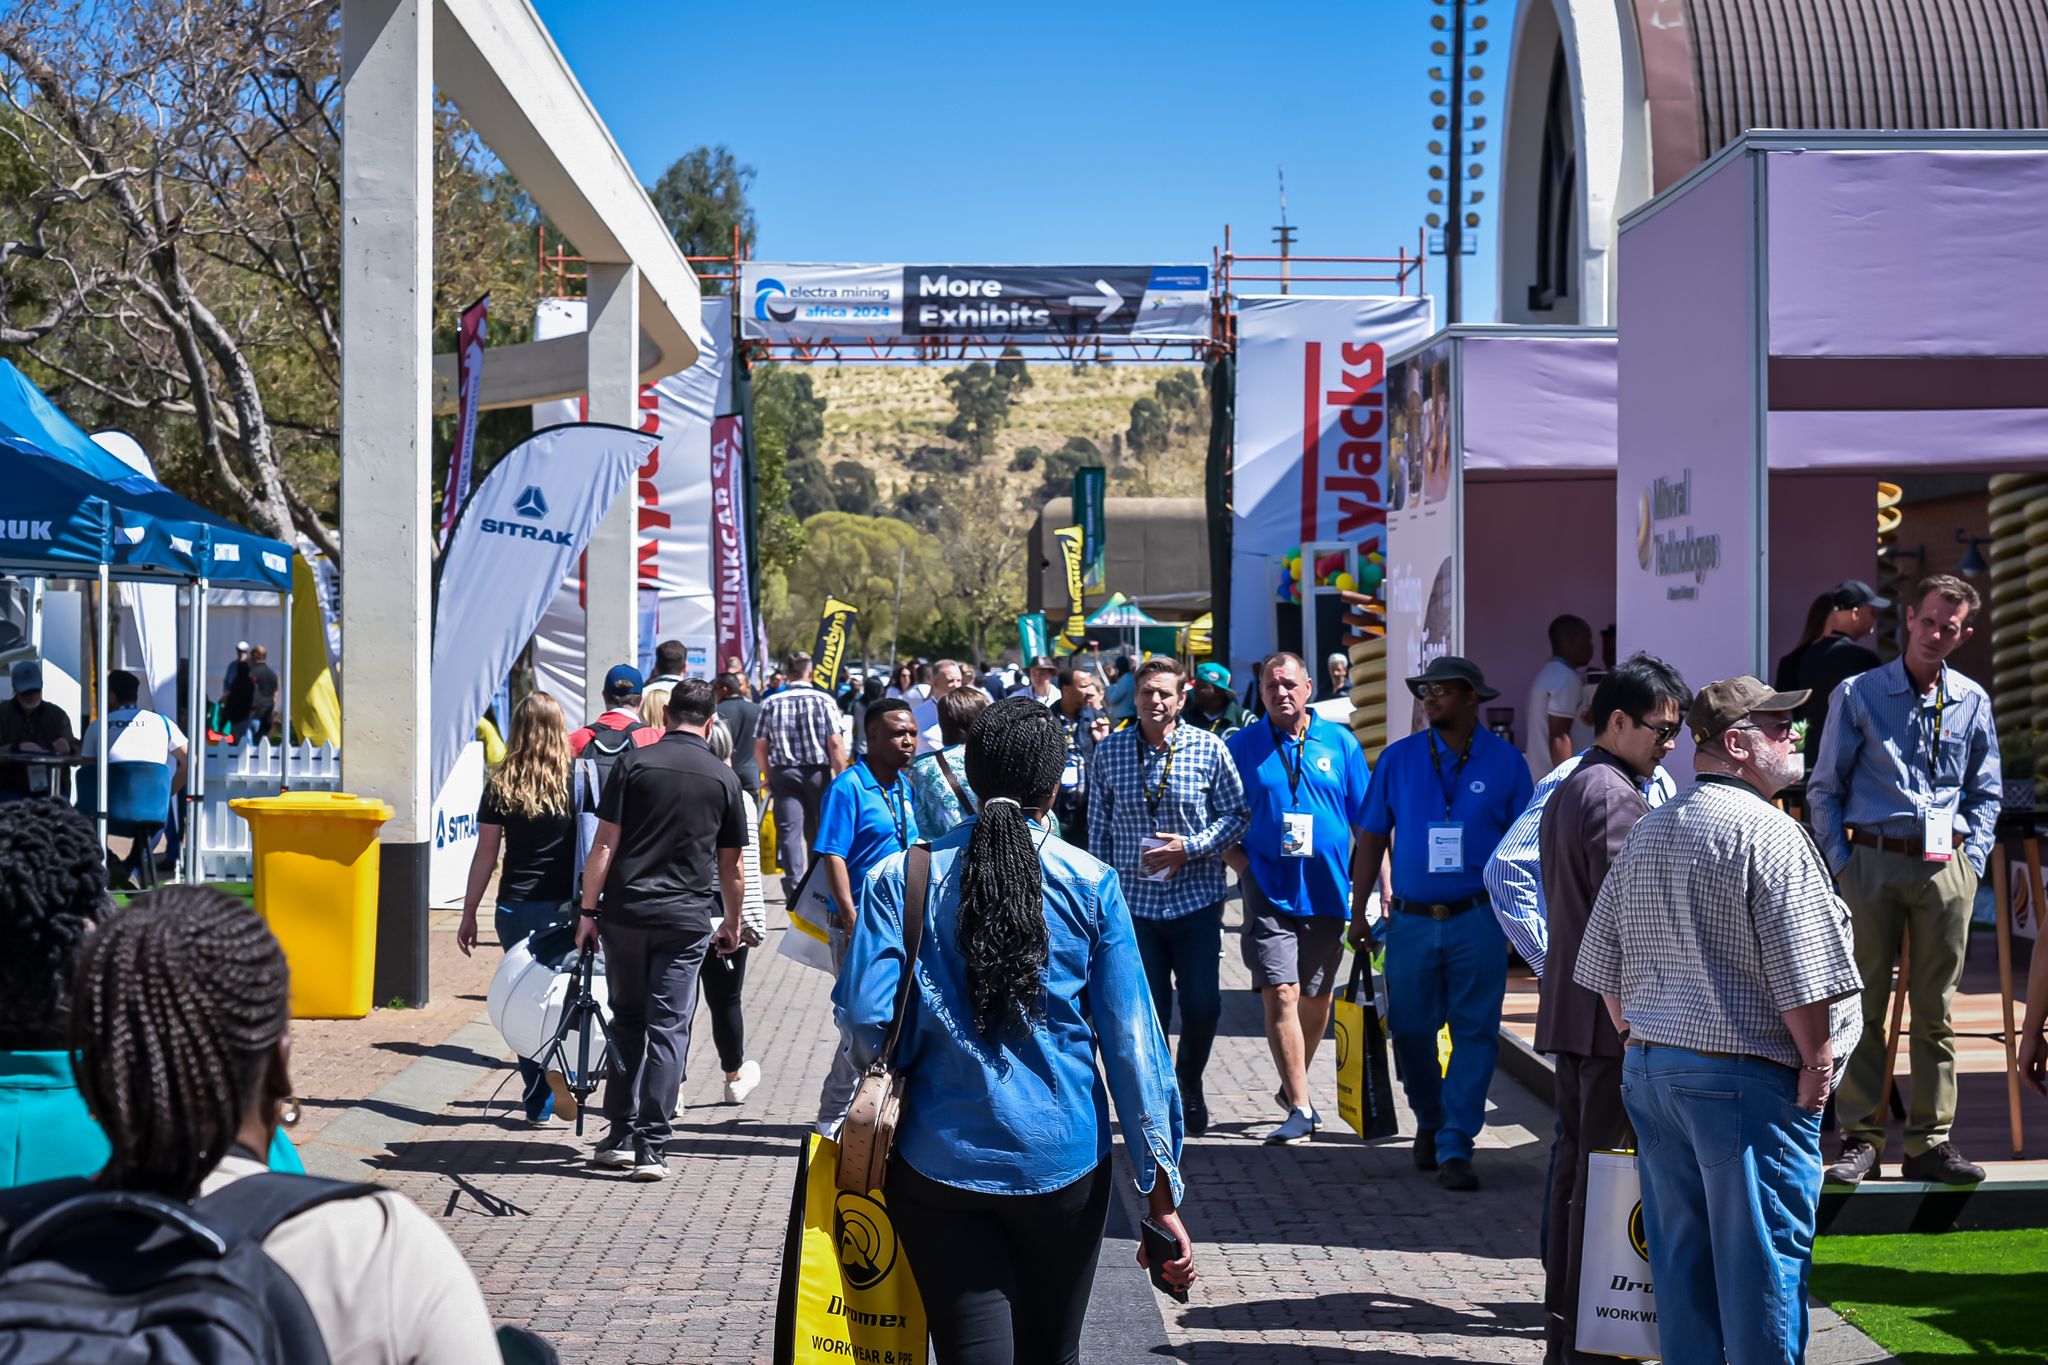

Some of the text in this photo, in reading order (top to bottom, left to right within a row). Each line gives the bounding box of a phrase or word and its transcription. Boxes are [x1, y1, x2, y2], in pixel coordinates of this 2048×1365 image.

[790, 285, 891, 300] electra mining
[919, 274, 1003, 298] More
[805, 305, 890, 318] africa 2024
[919, 302, 1050, 328] Exhibits
[0, 520, 52, 541] UK
[480, 518, 576, 547] SITRAK
[813, 612, 847, 690] Flowbins
[827, 1295, 908, 1328] Dromex
[811, 1335, 914, 1365] WORKWEAR & PPE
